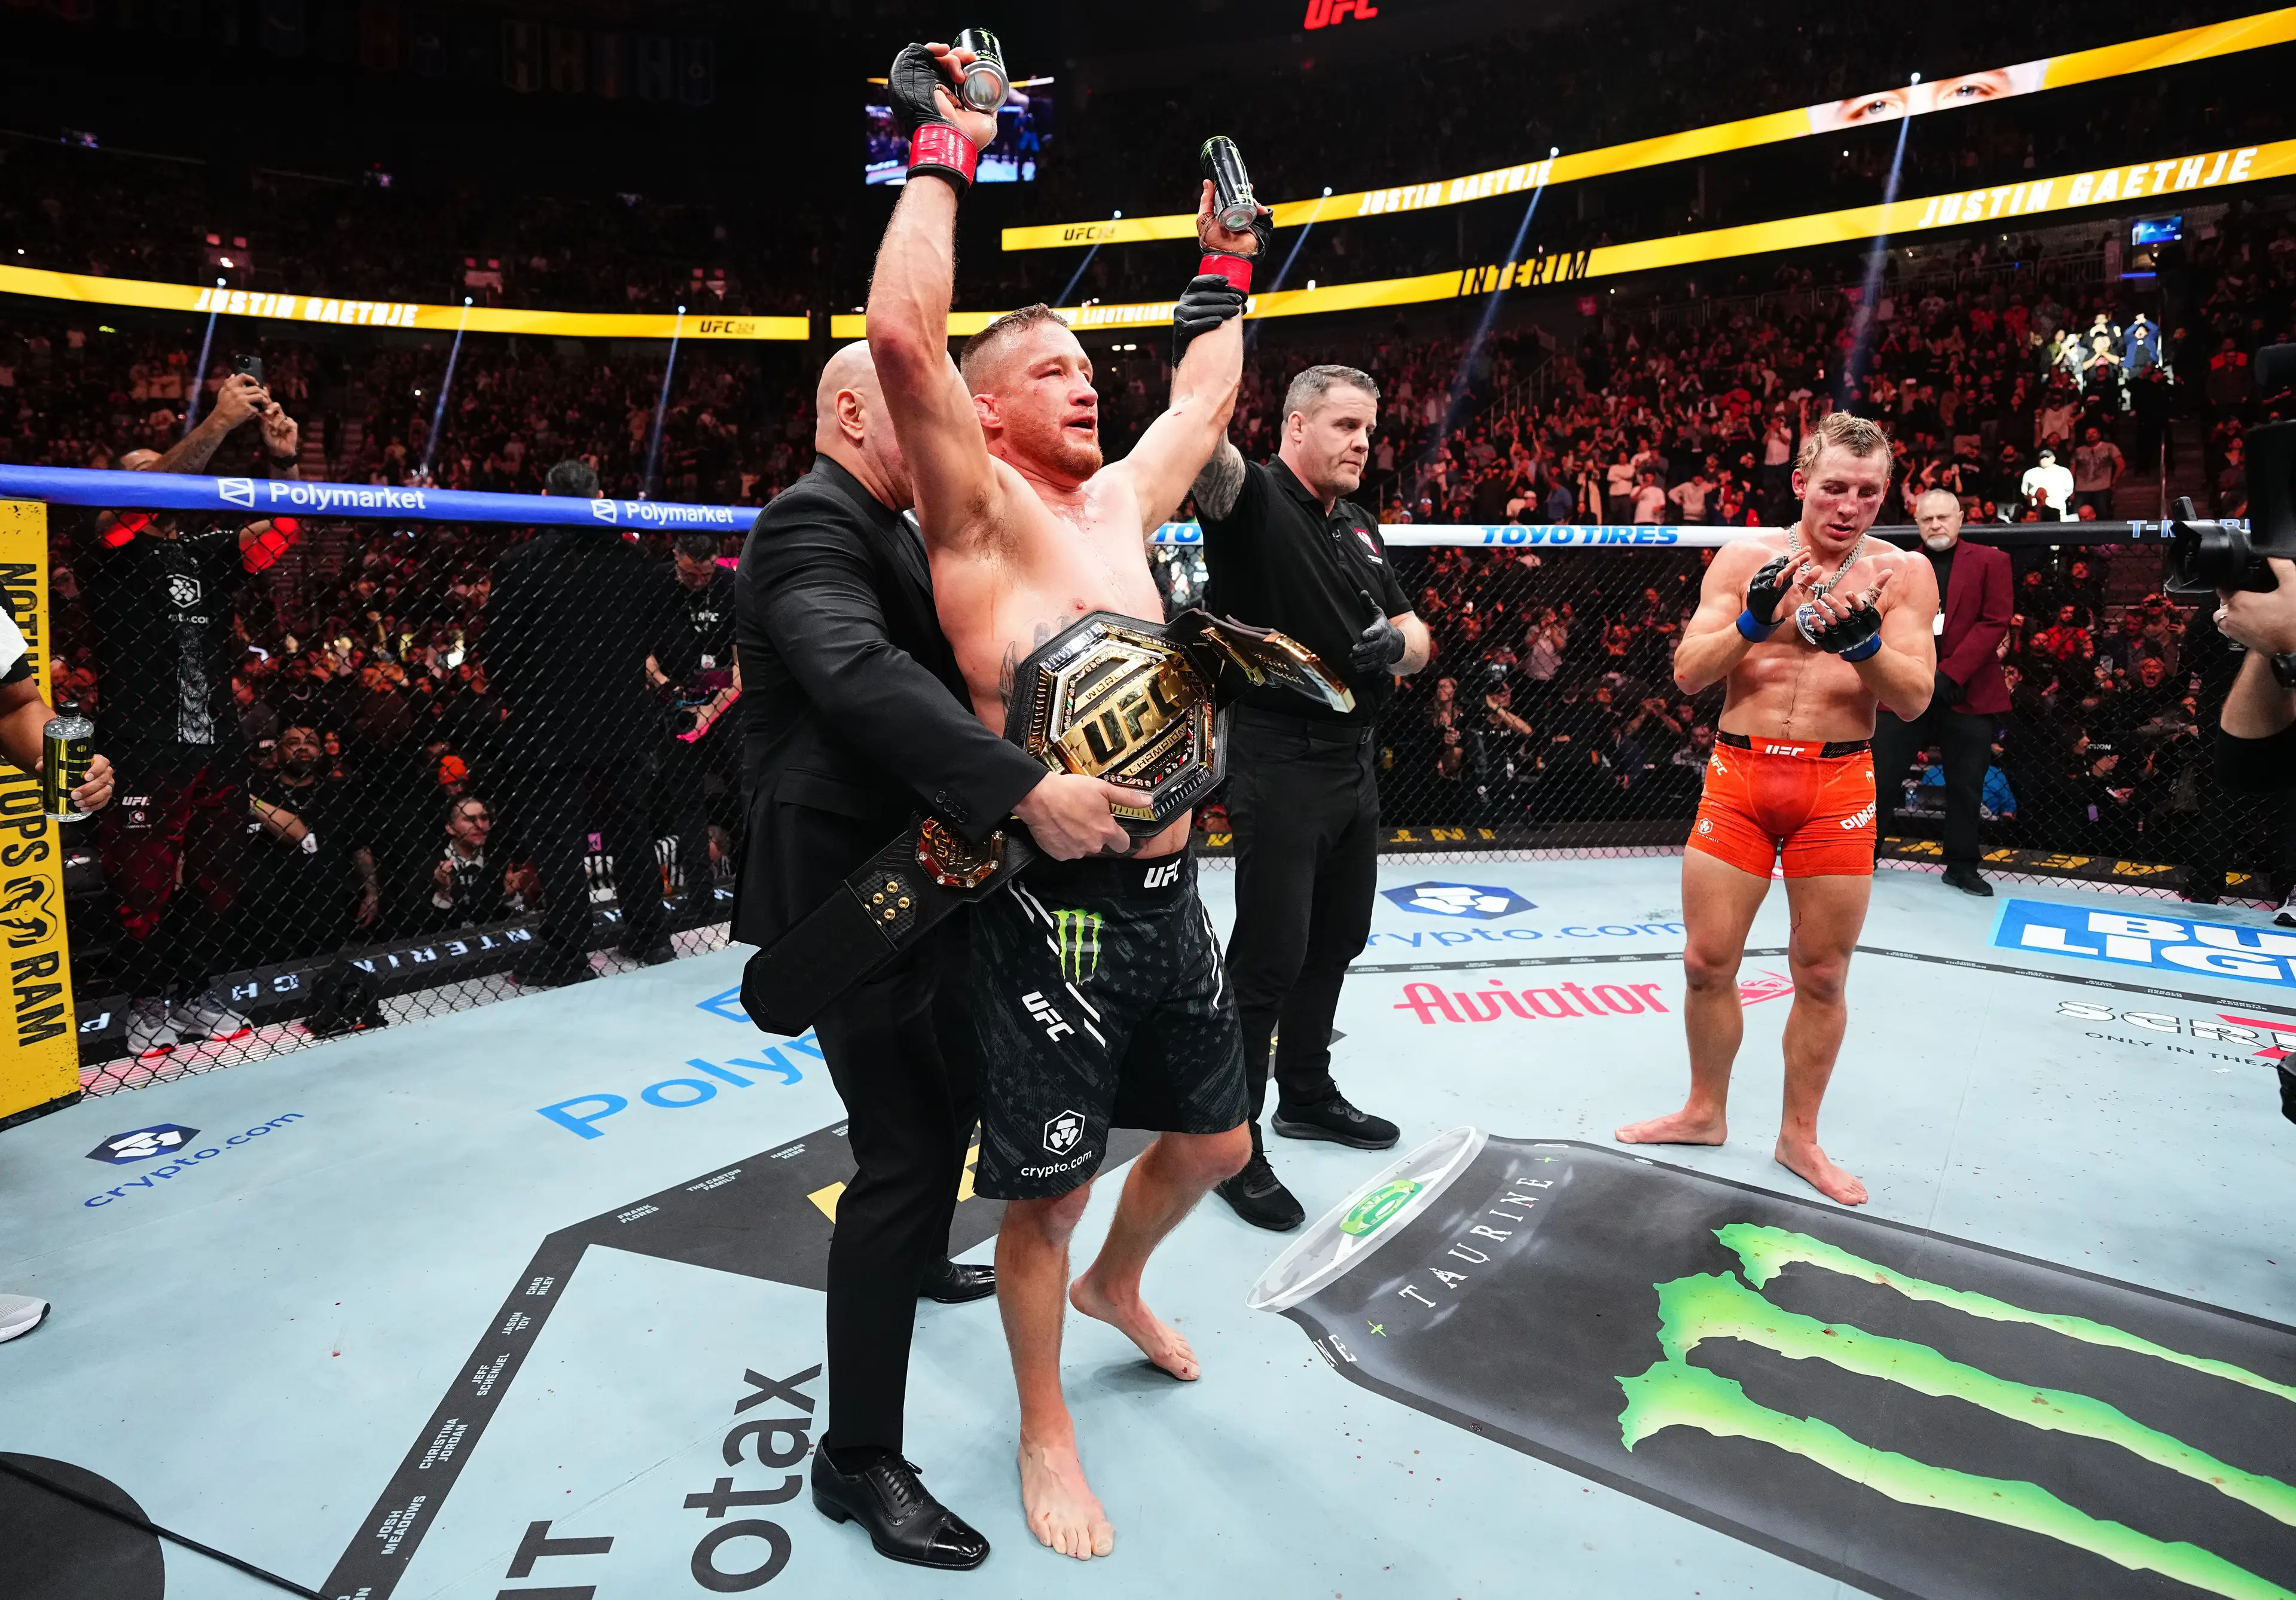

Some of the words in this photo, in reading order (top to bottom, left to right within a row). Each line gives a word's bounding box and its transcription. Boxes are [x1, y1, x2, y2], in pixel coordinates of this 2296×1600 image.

[1358, 184, 1442, 216] JUSTIN
[1919, 181, 2053, 227] JUSTIN
[2068, 148, 2257, 198] GAETHJE
[1064, 227, 1096, 240] UFC
[1458, 249, 1592, 297] INTERIM
[194, 289, 296, 317] JUSTIN
[700, 320, 735, 334] UFC
[268, 481, 427, 511] Polymarket
[624, 501, 734, 527] Polymarket
[1481, 527, 1576, 545] TOYO
[1579, 527, 1678, 545] TIRES
[1085, 664, 1131, 701] WORLD
[1081, 668, 1184, 765] UFC
[1128, 726, 1186, 774] CHAMPION
[1711, 754, 1727, 775] UFC
[0, 758, 50, 868] TOPS
[1143, 858, 1181, 888] UFC
[1366, 923, 1685, 948] rypto.com
[2020, 924, 2296, 988] LIG
[10, 951, 67, 1048] RAM
[1393, 979, 1671, 1025] Aviator
[1022, 990, 1075, 1043] UFC
[2085, 1032, 2153, 1047] ONLY
[2167, 1045, 2194, 1055] IN
[84, 1113, 305, 1208] crypto.com
[770, 1143, 805, 1159] HANNAH
[781, 1148, 806, 1160] KERR
[1021, 1149, 1092, 1178] crypto.com
[686, 1183, 706, 1192] THE
[704, 1168, 742, 1185] CASTON
[703, 1175, 737, 1191] FAMILY
[616, 1204, 652, 1219] FRANK
[619, 1207, 660, 1224] FLORES
[1398, 1177, 1555, 1308] TAURINE
[525, 1277, 544, 1295] CHAD
[536, 1276, 555, 1296] RILEY
[501, 1312, 523, 1335] JASON
[515, 1316, 532, 1331] TOY
[471, 1364, 490, 1384] JEFF
[419, 1418, 459, 1469] CHRISTINA
[437, 1424, 469, 1462] JORDAN
[683, 1363, 823, 1593] otax
[376, 1510, 403, 1540] JOSH
[380, 1495, 426, 1555] MEADOWS
